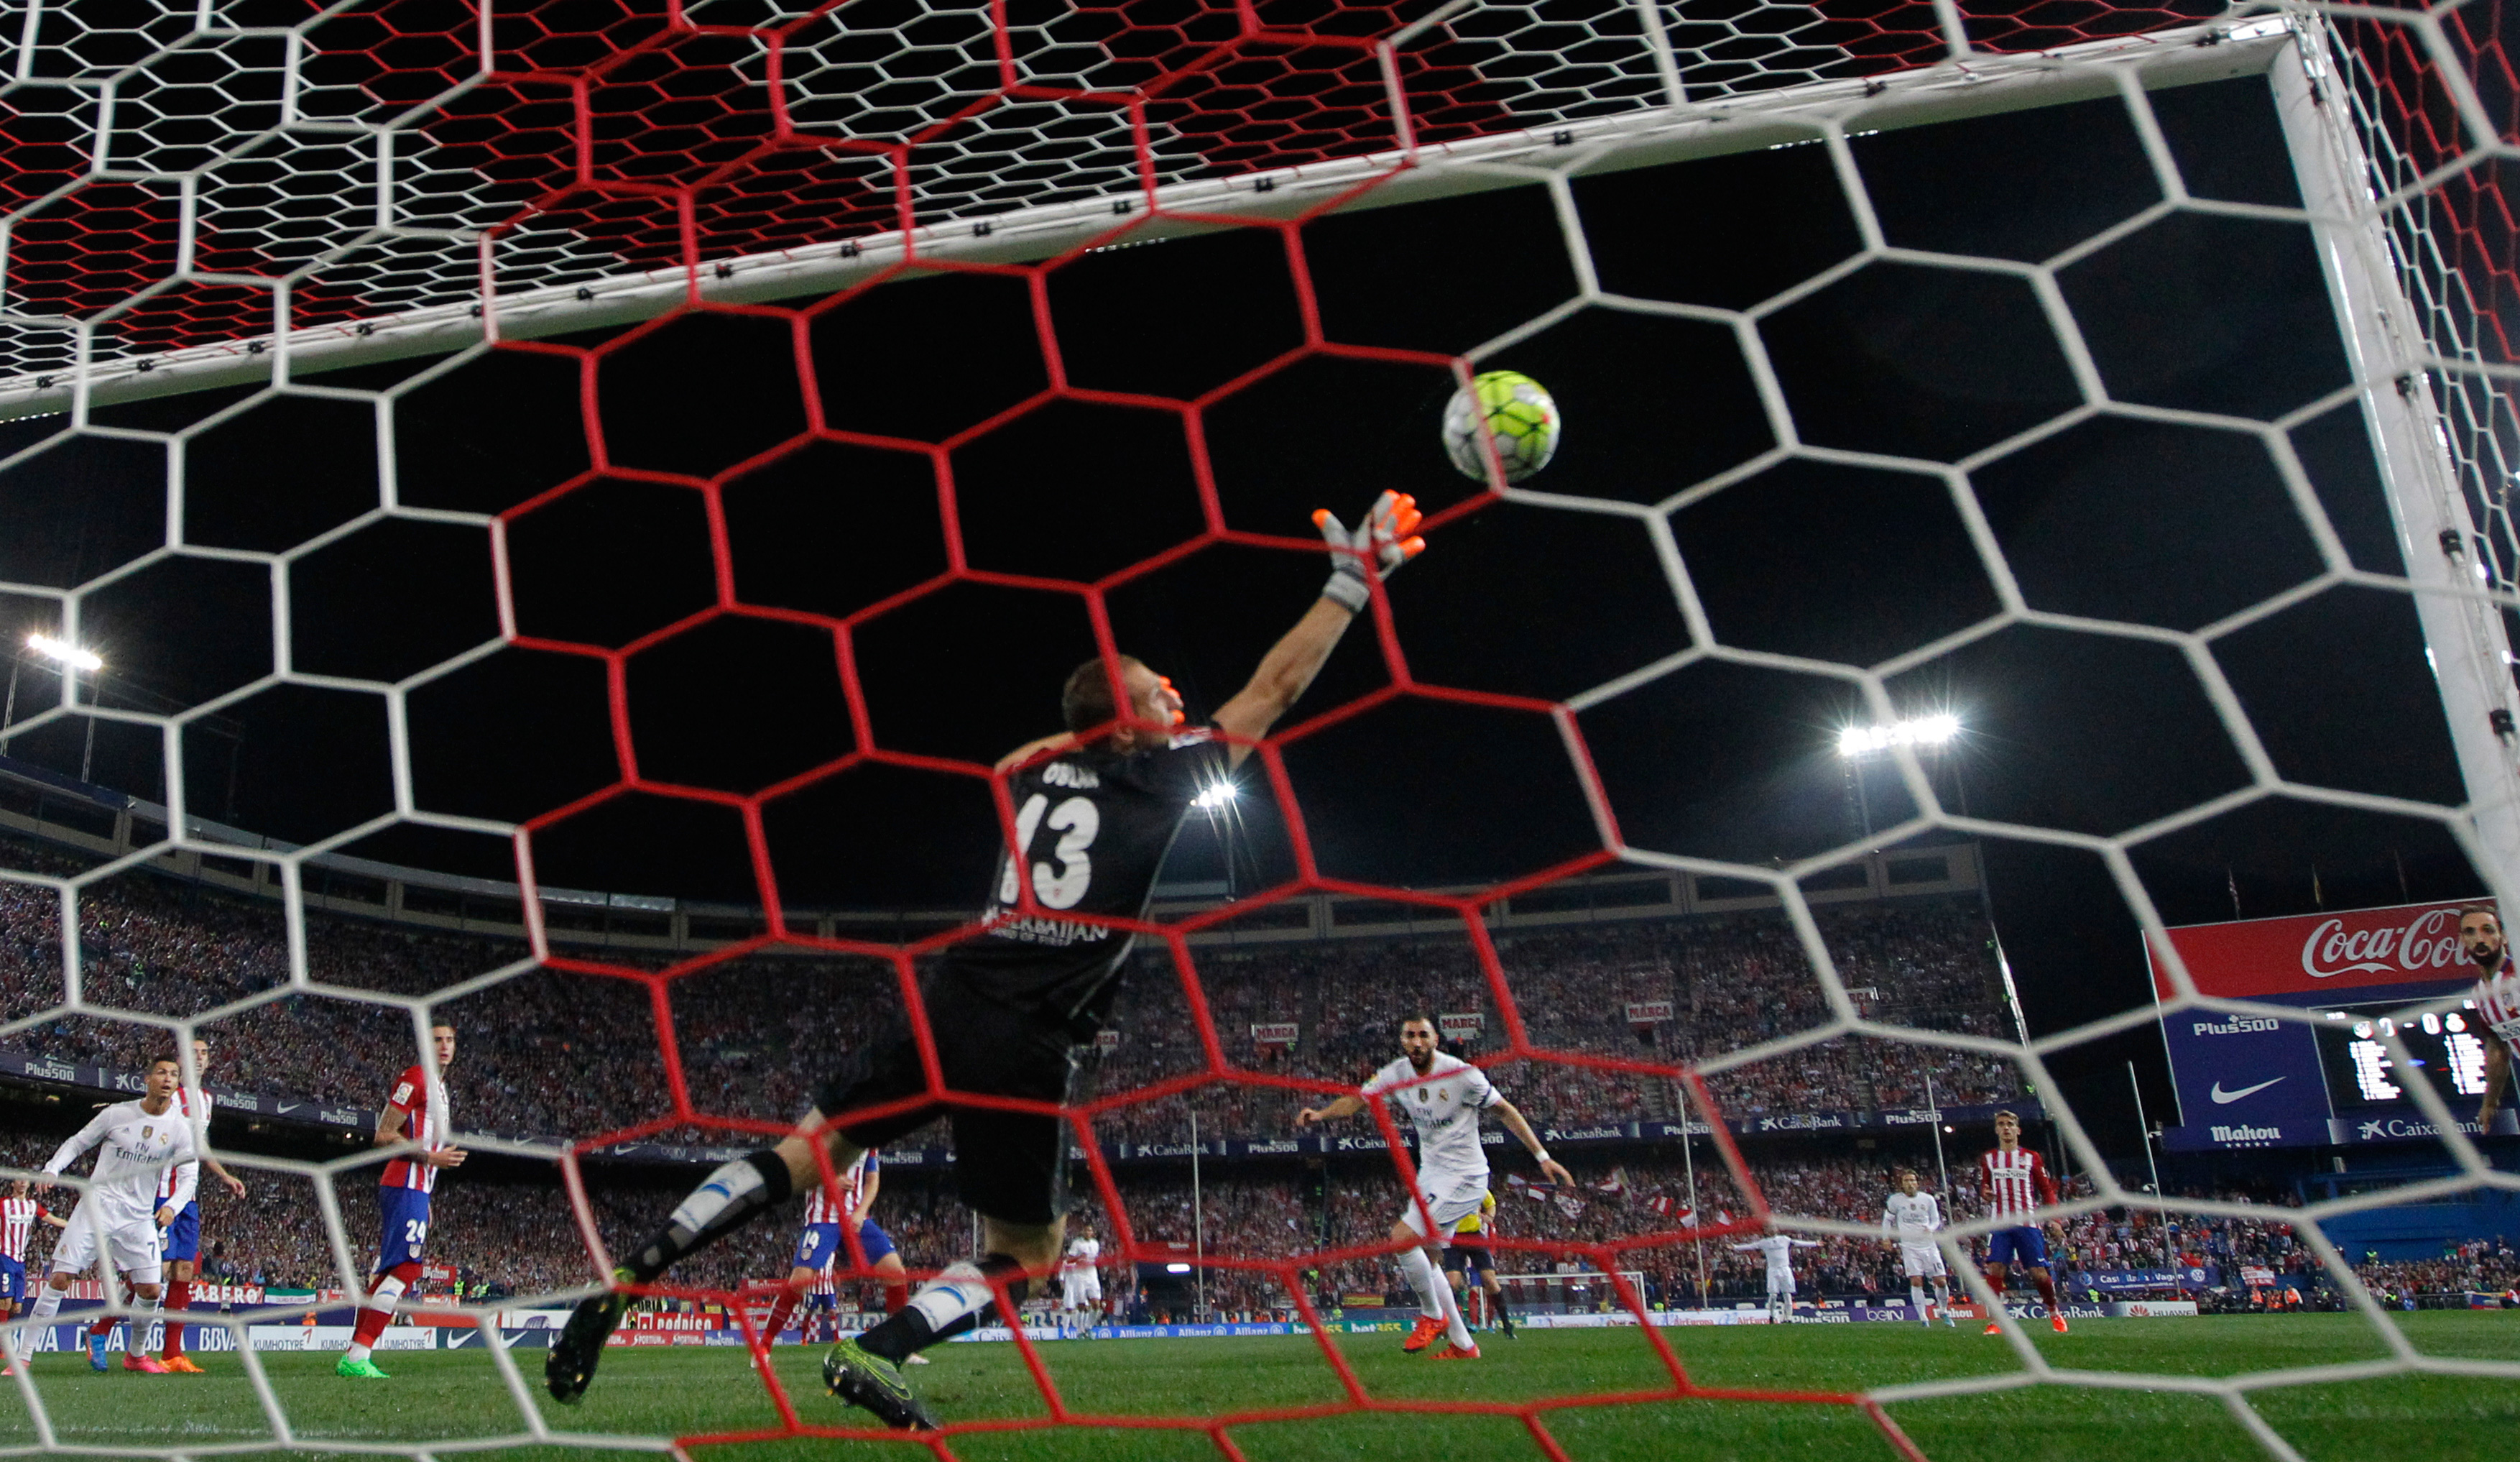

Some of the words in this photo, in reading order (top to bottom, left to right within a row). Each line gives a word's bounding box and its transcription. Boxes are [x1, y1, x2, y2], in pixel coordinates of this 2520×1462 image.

[1000, 794, 1099, 910] 13
[1628, 1006, 1669, 1018] MARCA
[1441, 1018, 1482, 1029] MARCA
[2193, 1019, 2279, 1036] Plus500
[2422, 1013, 2442, 1034] 0
[1257, 1028, 1296, 1039] MARCA
[26, 1062, 75, 1081] Plus500
[216, 1094, 257, 1111] Plus500
[320, 1111, 358, 1126] Plus500
[1886, 1113, 1943, 1125] Plus500
[1563, 1126, 1623, 1140] CaixaBank
[2210, 1124, 2281, 1142] Mahou
[1249, 1143, 1298, 1153] Plus500
[405, 1219, 427, 1243] 24
[803, 1230, 820, 1249] 14
[147, 1241, 157, 1261] 7
[2, 1273, 10, 1284] 5
[1866, 1309, 1904, 1321] beIN
[1120, 1329, 1153, 1338] Allianz
[1178, 1328, 1211, 1337] Allianz
[1234, 1327, 1267, 1335] Allianz
[1352, 1321, 1402, 1333] bet365
